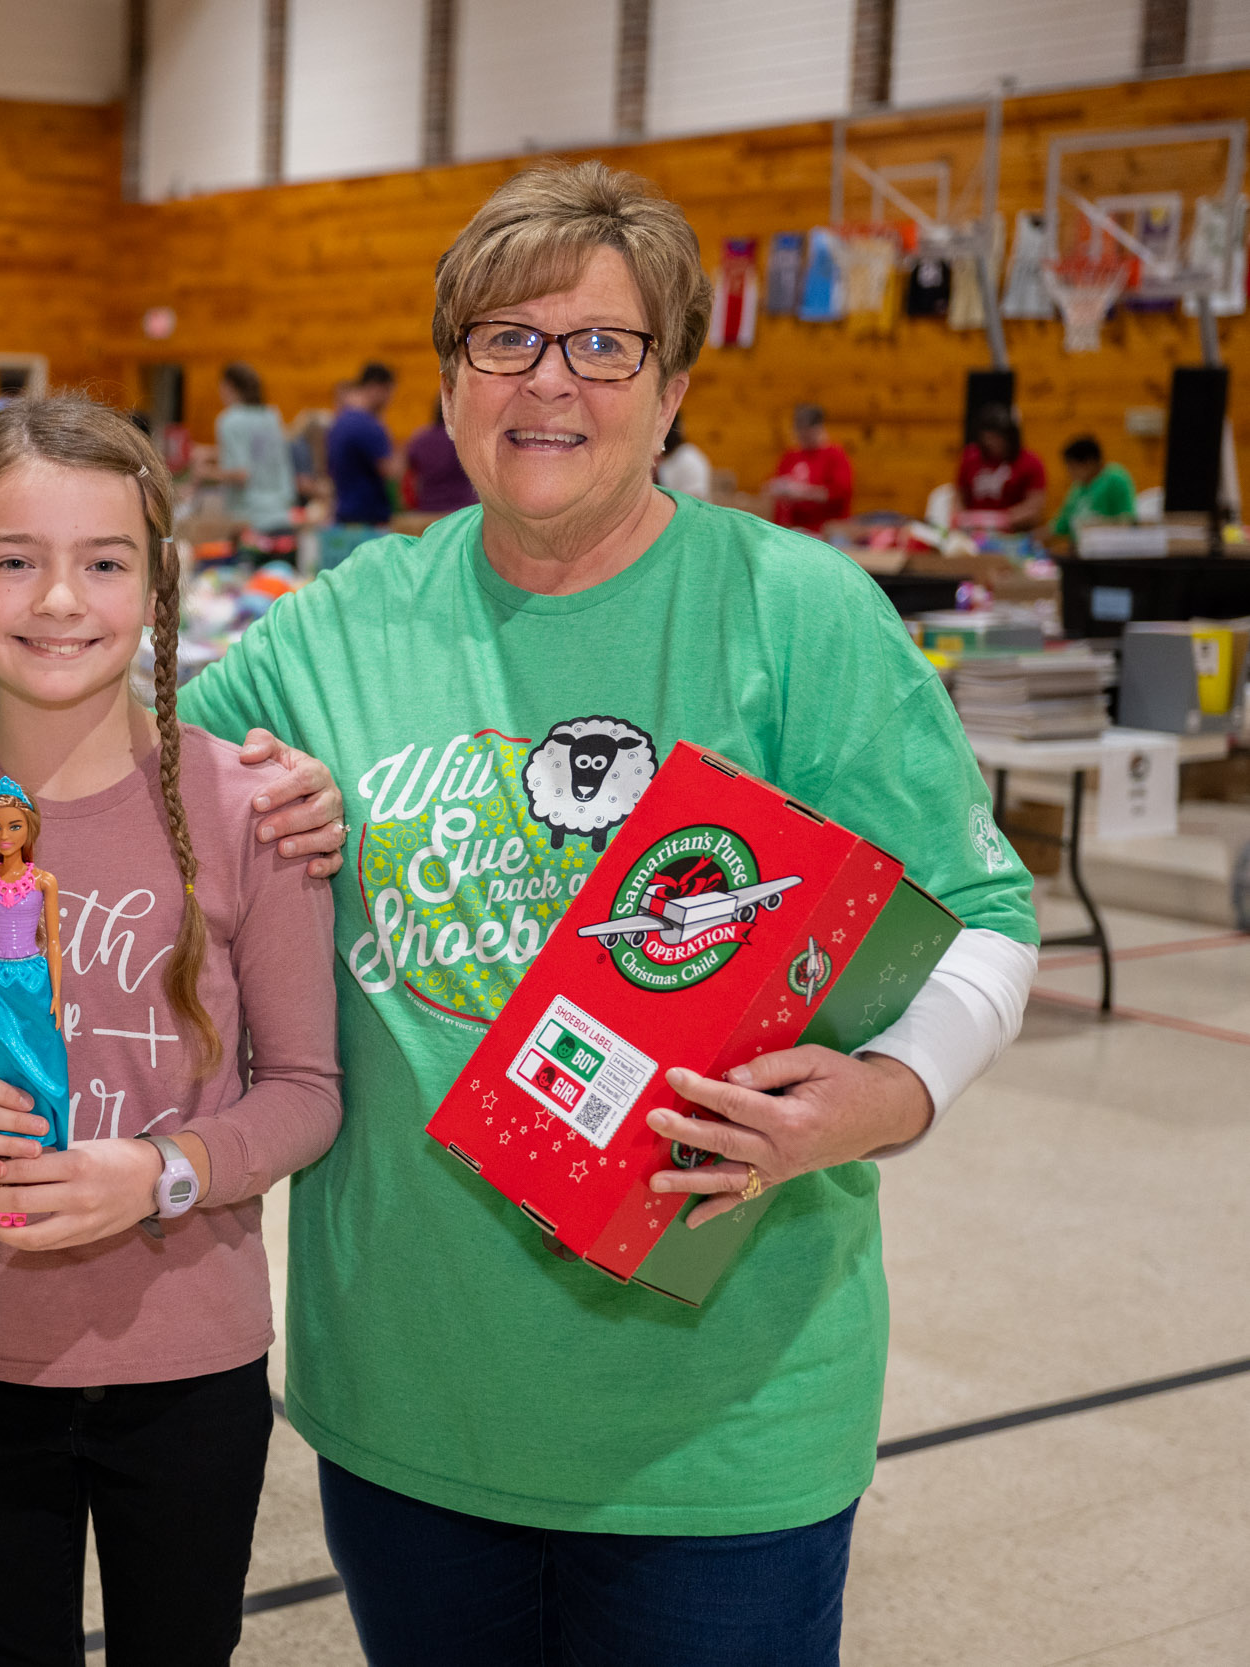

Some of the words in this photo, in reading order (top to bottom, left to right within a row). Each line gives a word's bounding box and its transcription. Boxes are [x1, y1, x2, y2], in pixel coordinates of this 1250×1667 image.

[357, 734, 498, 823] Will
[407, 805, 530, 903] Ewe
[616, 831, 713, 915] Samaritan's
[711, 834, 748, 887] Purse
[485, 869, 562, 910] pack
[349, 887, 561, 994] Shoeb
[646, 926, 736, 962] OPERATION
[620, 951, 678, 985] Christmas
[681, 950, 719, 981] Child
[555, 1005, 590, 1034] SHOEBOX
[588, 1029, 612, 1053] LABEL
[570, 1048, 599, 1075] BOY
[551, 1076, 579, 1107] GIRL
